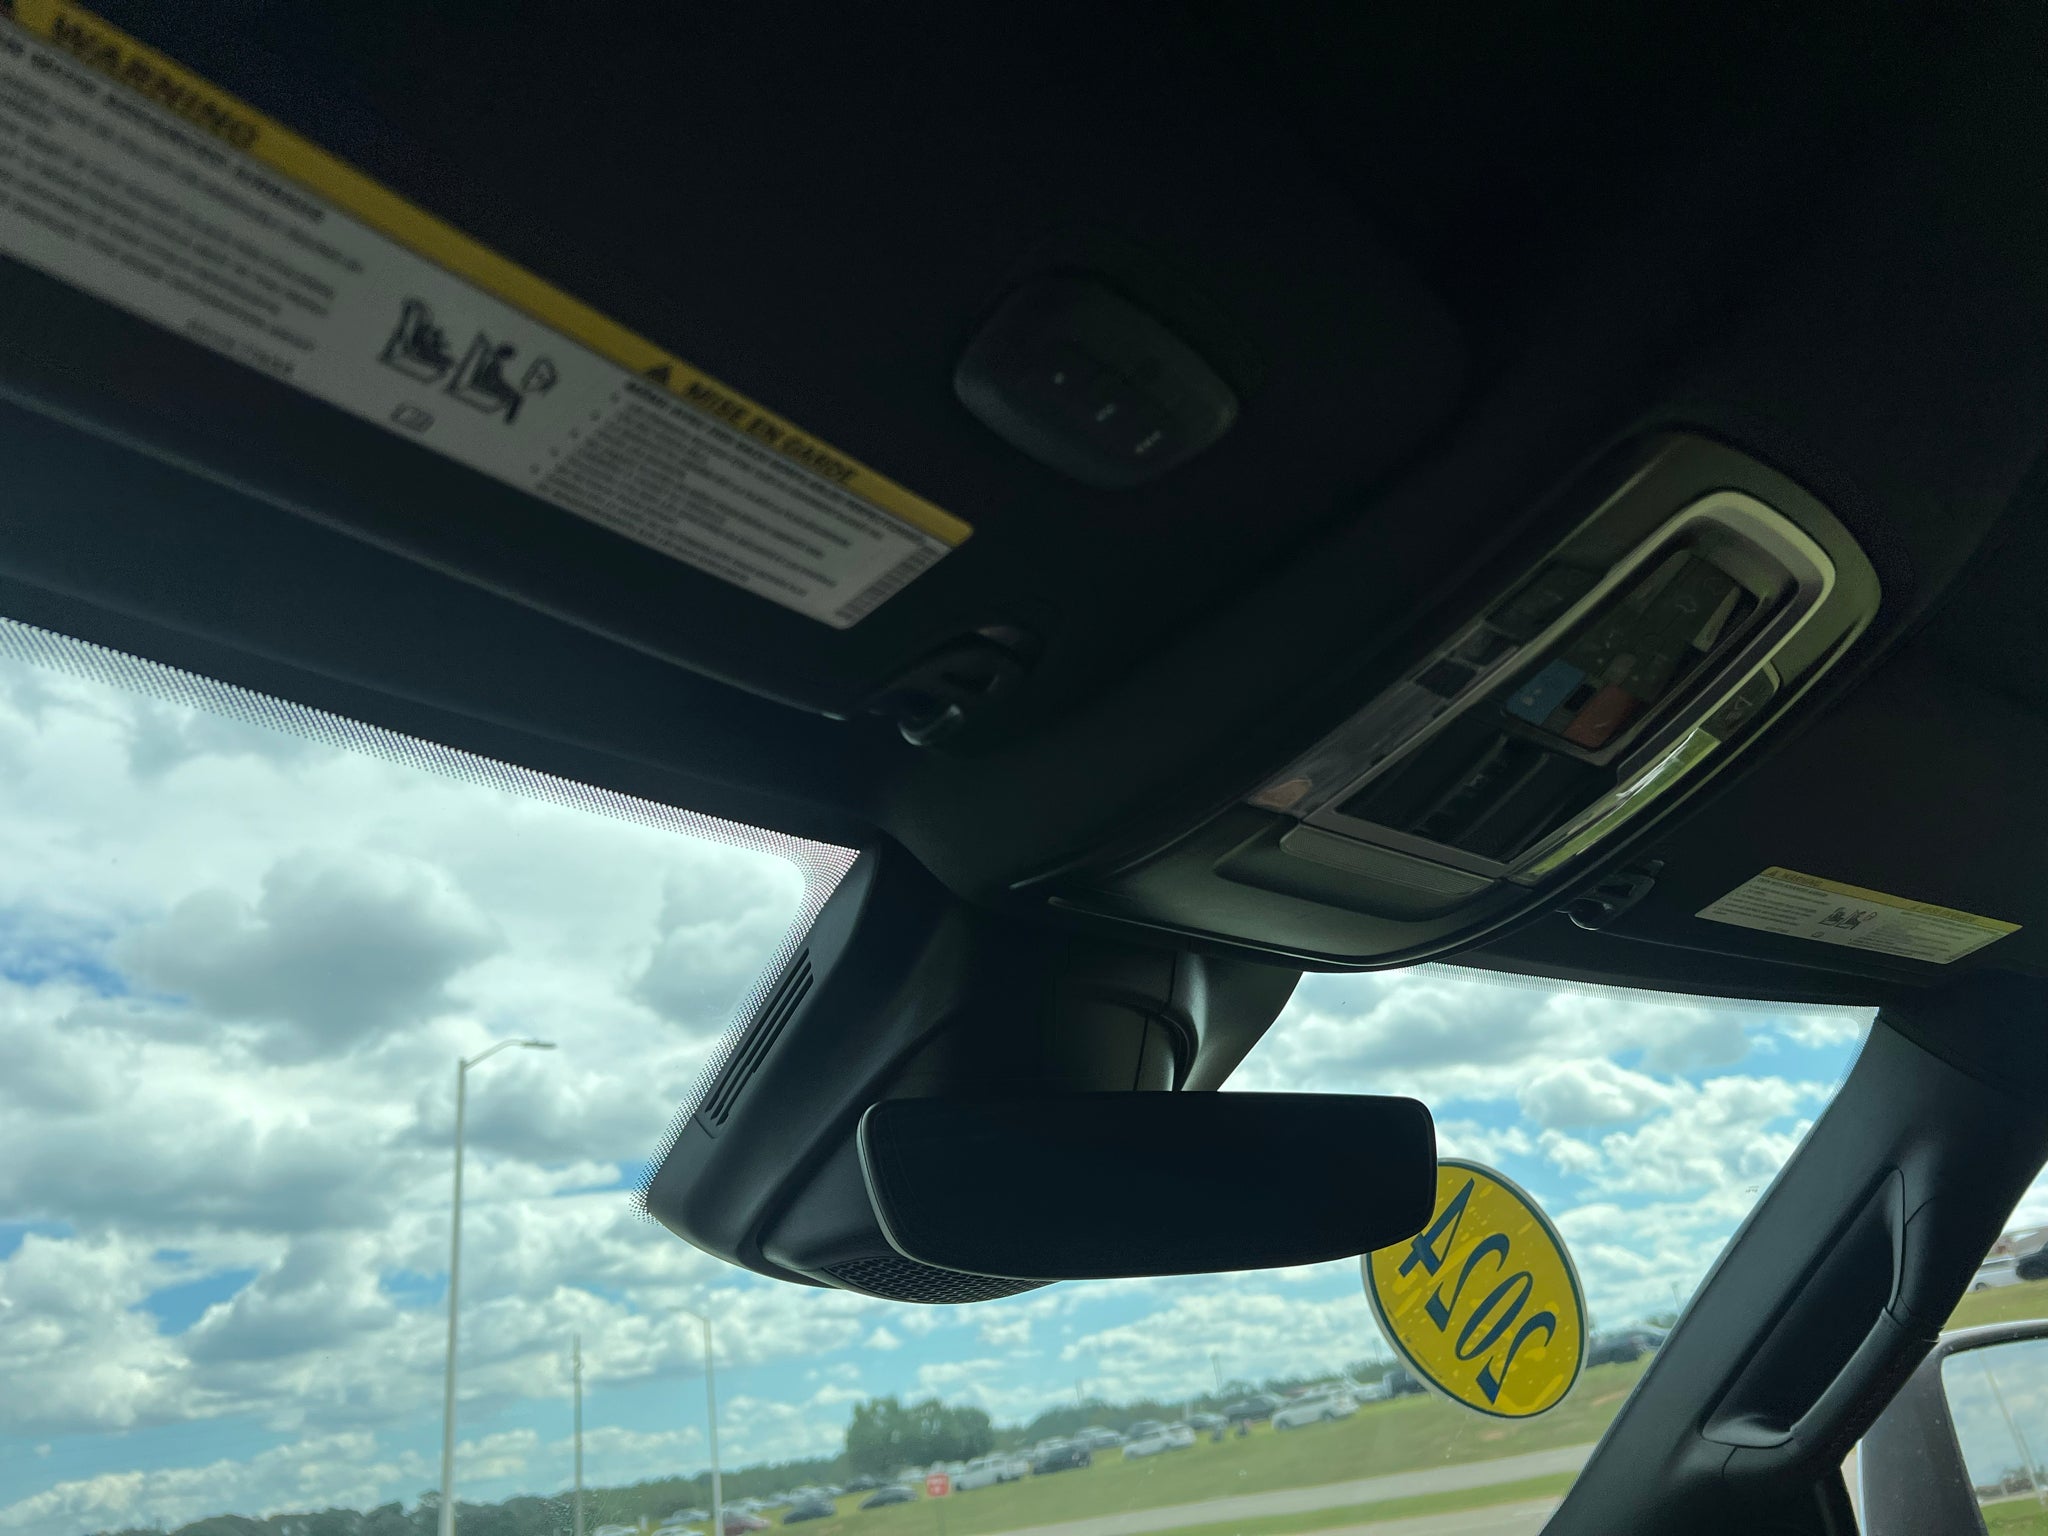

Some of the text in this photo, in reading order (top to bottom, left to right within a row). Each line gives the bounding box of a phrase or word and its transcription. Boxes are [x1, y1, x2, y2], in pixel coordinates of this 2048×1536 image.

[53, 14, 259, 149] WARNING
[687, 382, 857, 482] MISE EN GARDE
